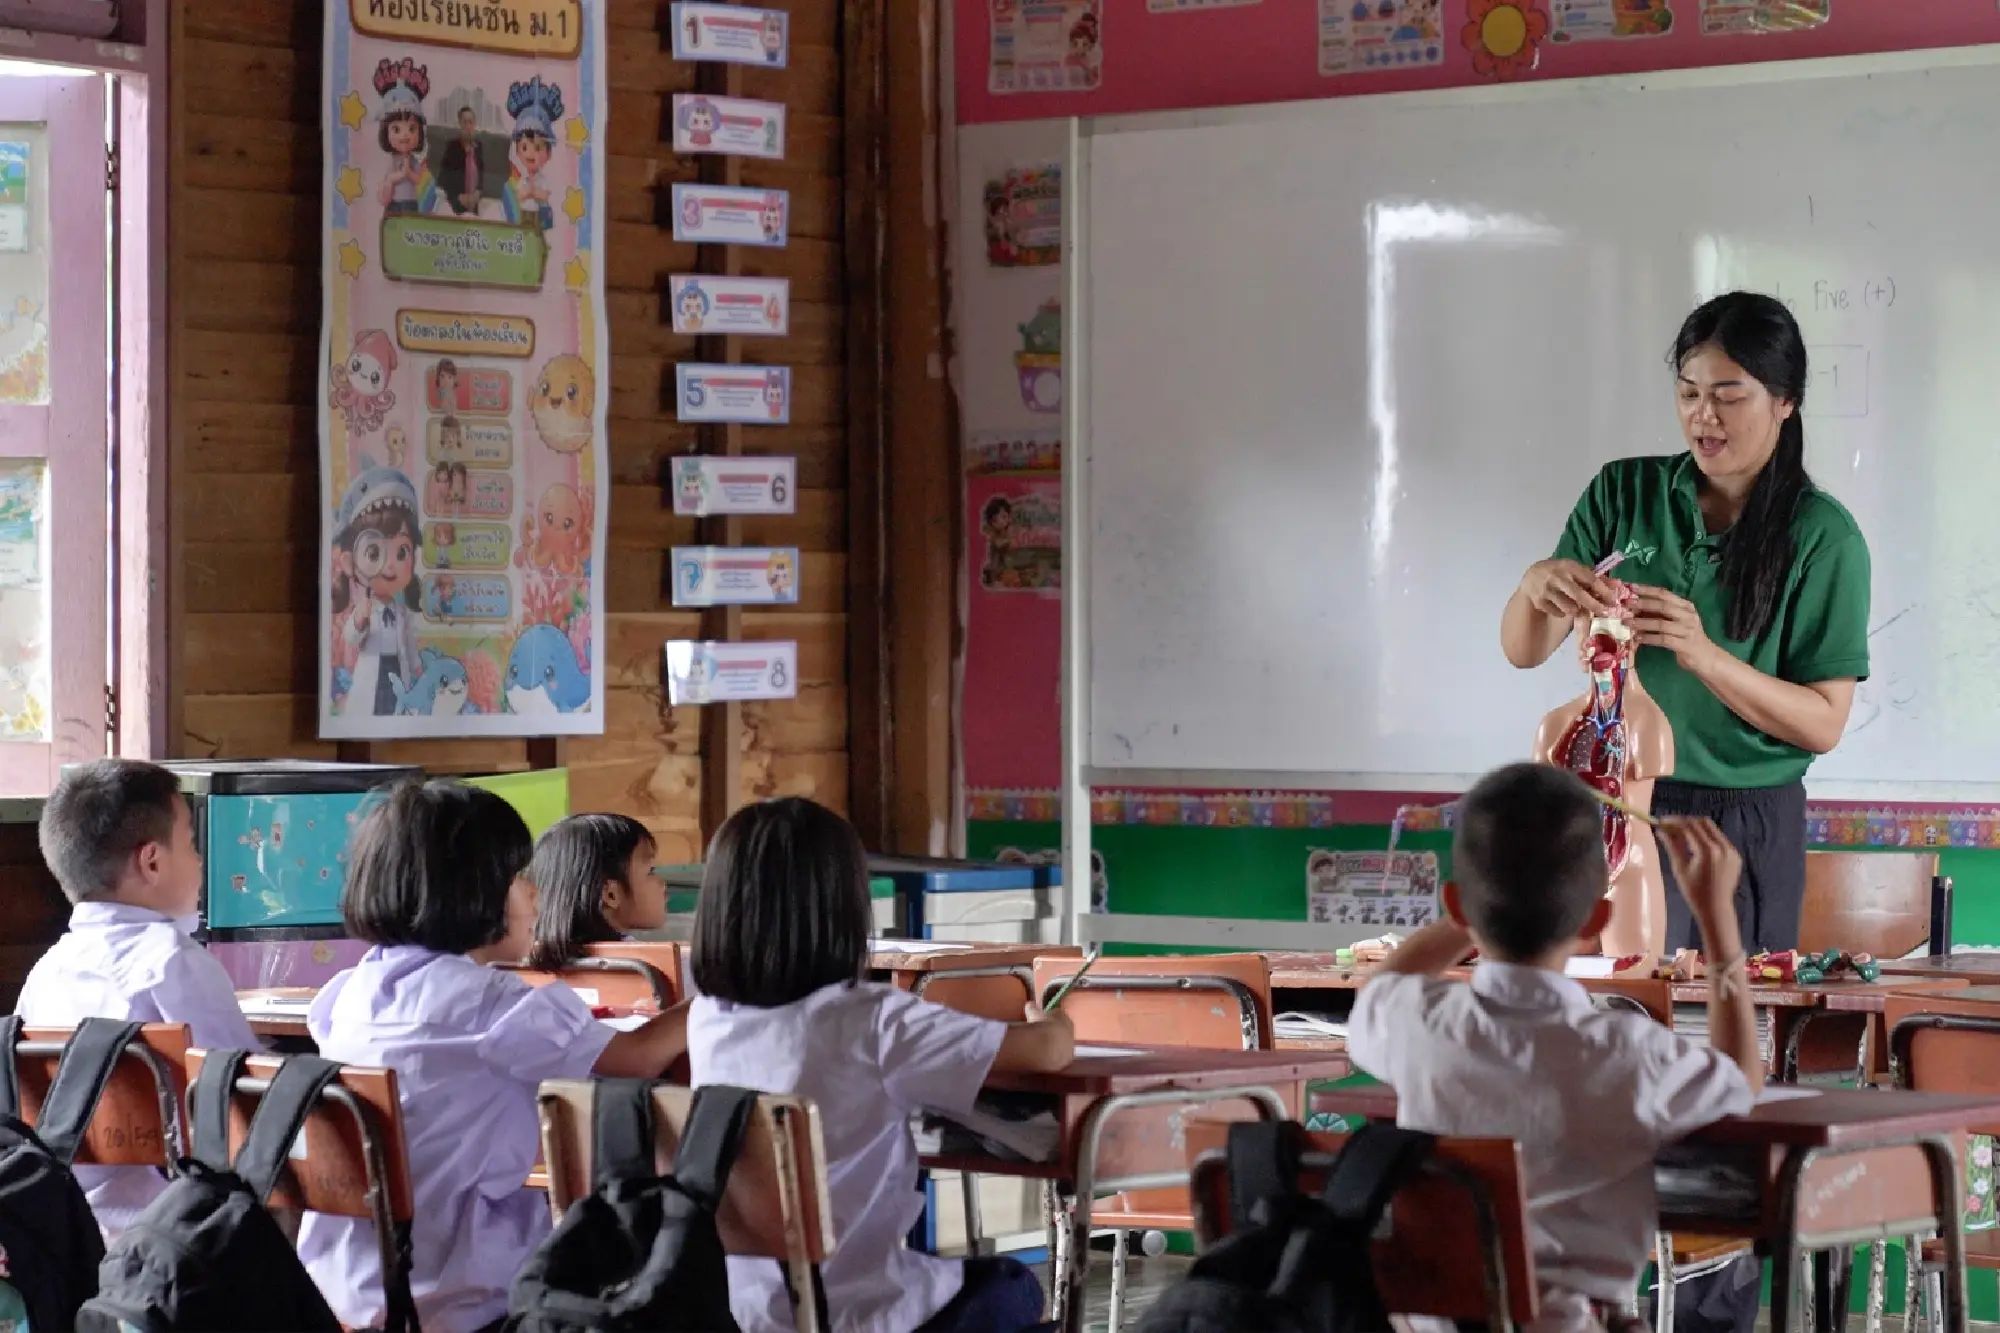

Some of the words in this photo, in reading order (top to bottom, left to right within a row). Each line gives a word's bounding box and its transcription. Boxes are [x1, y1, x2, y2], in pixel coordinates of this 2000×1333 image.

[530, 10, 568, 38] ม.1
[684, 15, 700, 48] 1
[764, 116, 779, 152] 2
[682, 195, 702, 230] 3
[1813, 279, 1850, 311] Five
[686, 378, 705, 408] 5
[771, 475, 787, 503] 6
[678, 560, 702, 593] 7
[770, 658, 787, 690] 8
